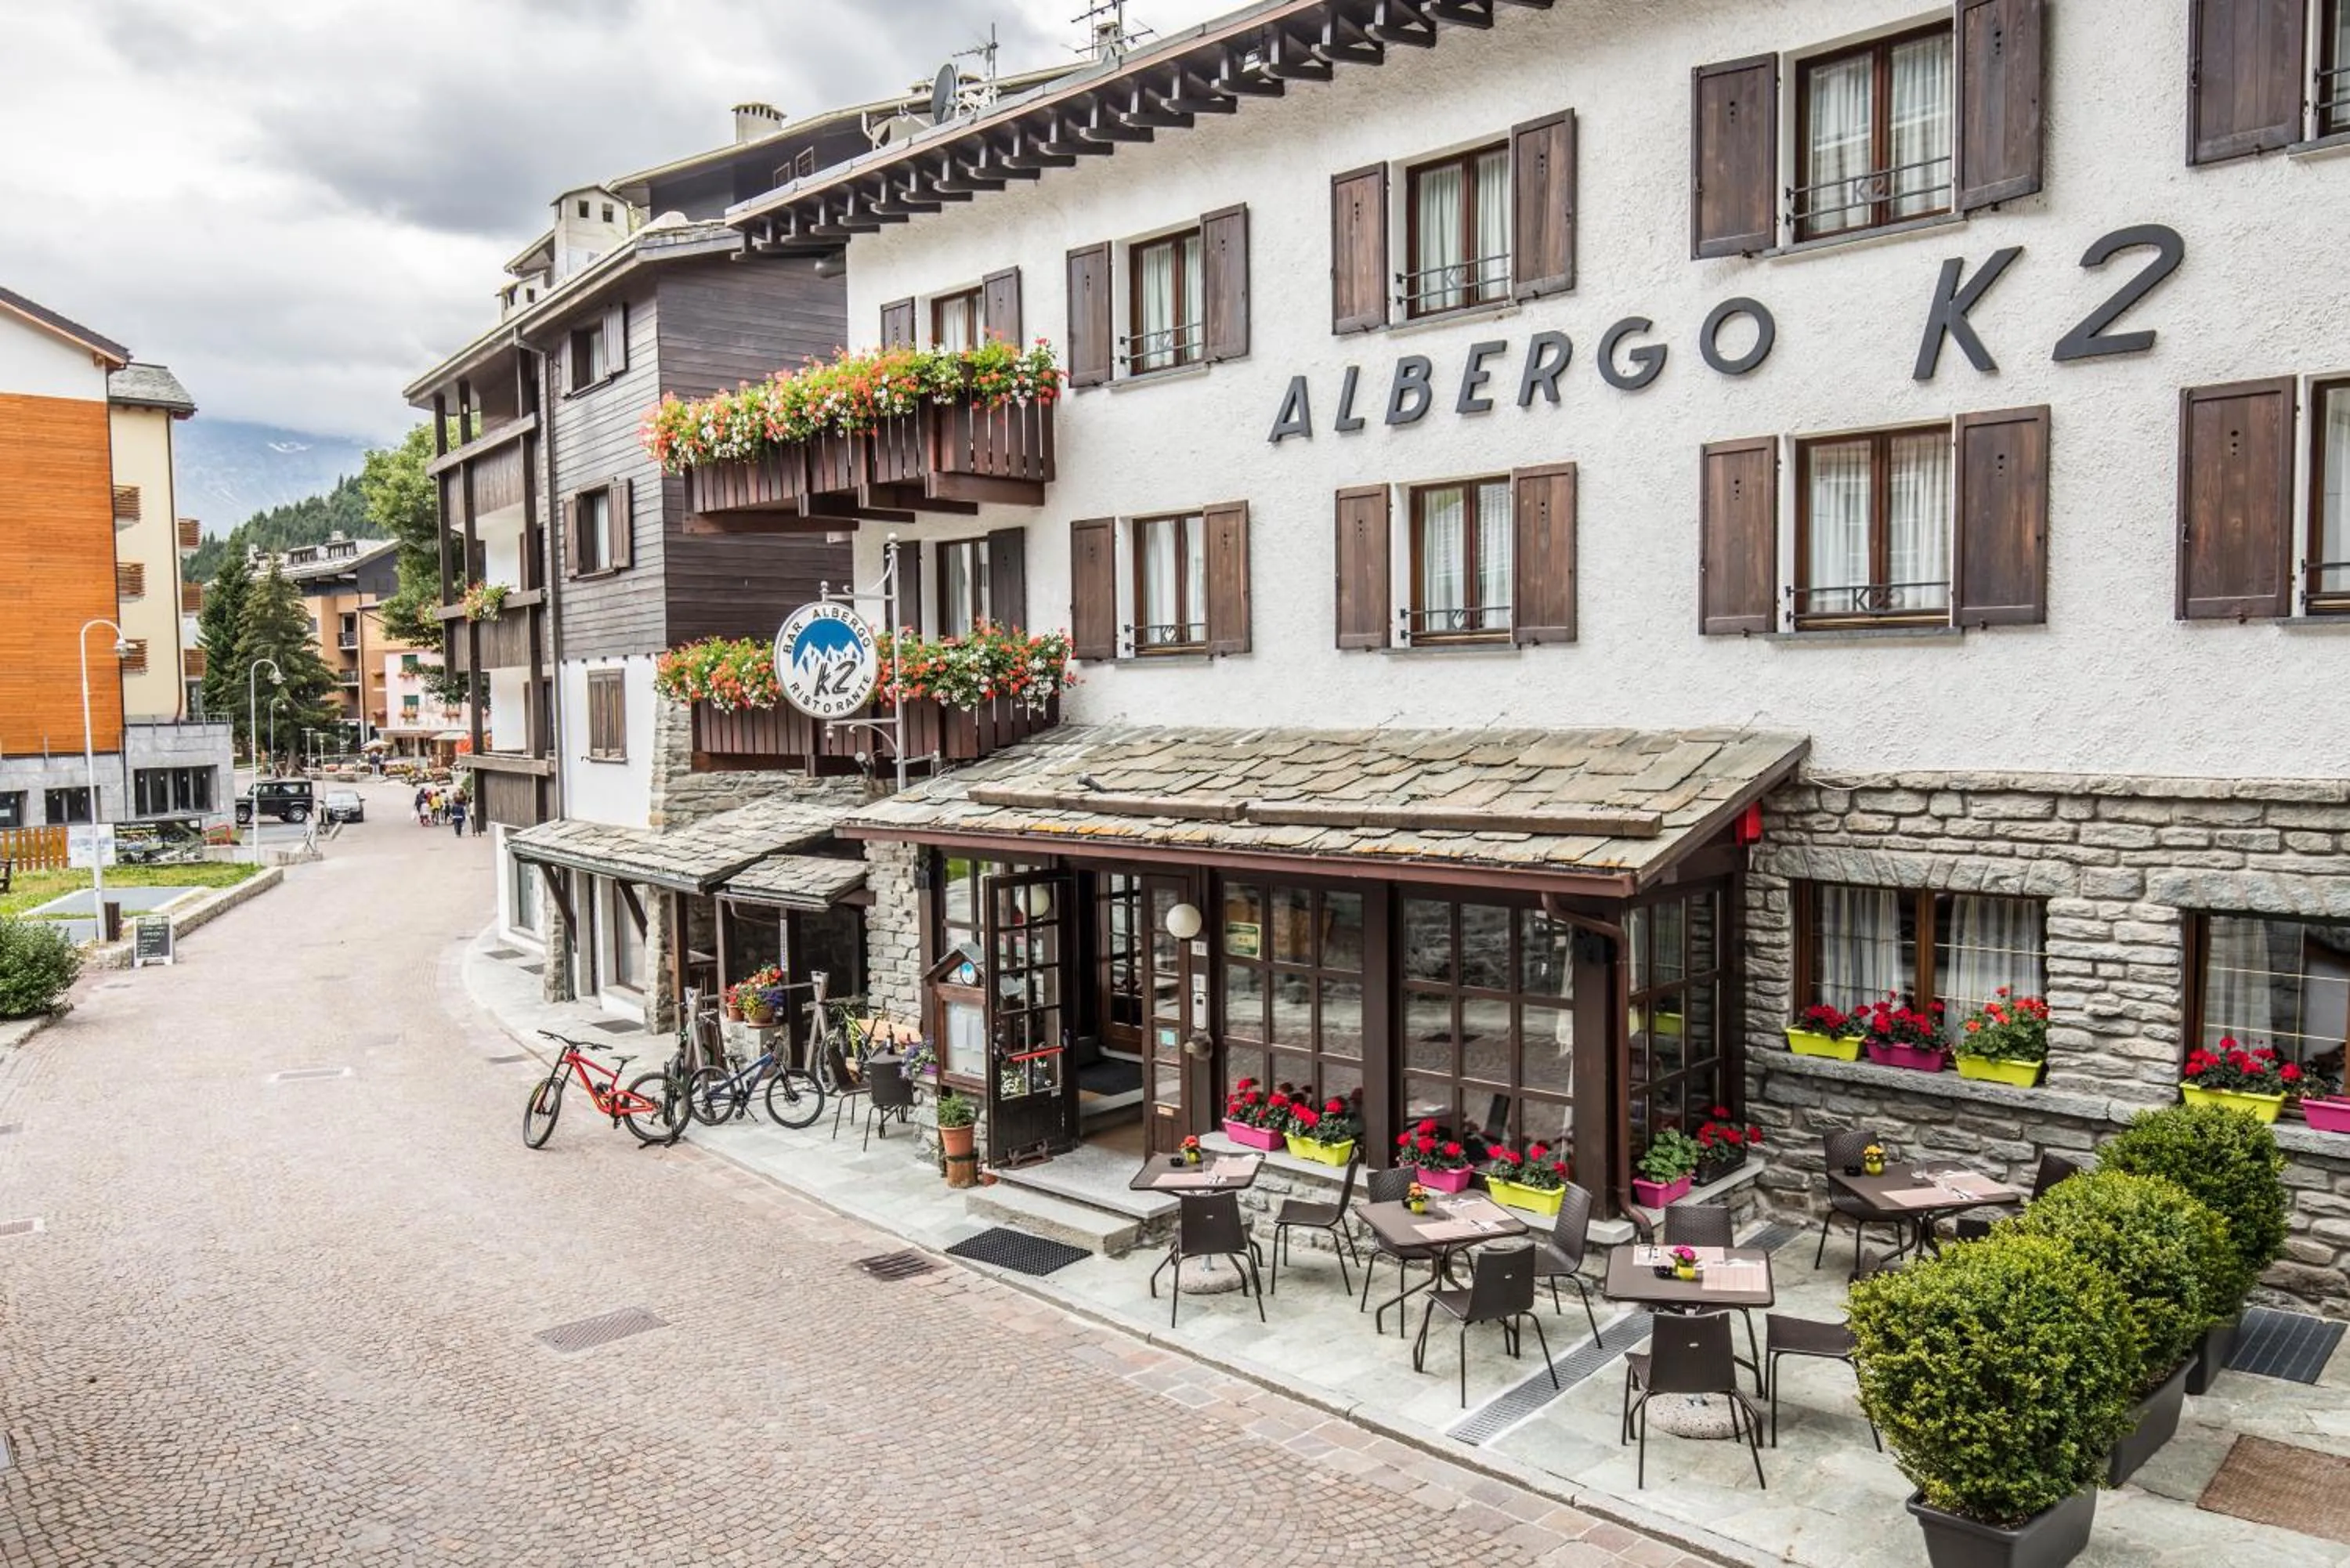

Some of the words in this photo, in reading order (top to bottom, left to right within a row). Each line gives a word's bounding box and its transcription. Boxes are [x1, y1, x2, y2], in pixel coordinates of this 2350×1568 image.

[1267, 296, 1777, 443] ALBERGO
[783, 621, 803, 654] BAR
[812, 607, 872, 649] ALBERGO
[790, 674, 872, 714] RISTORANTE
